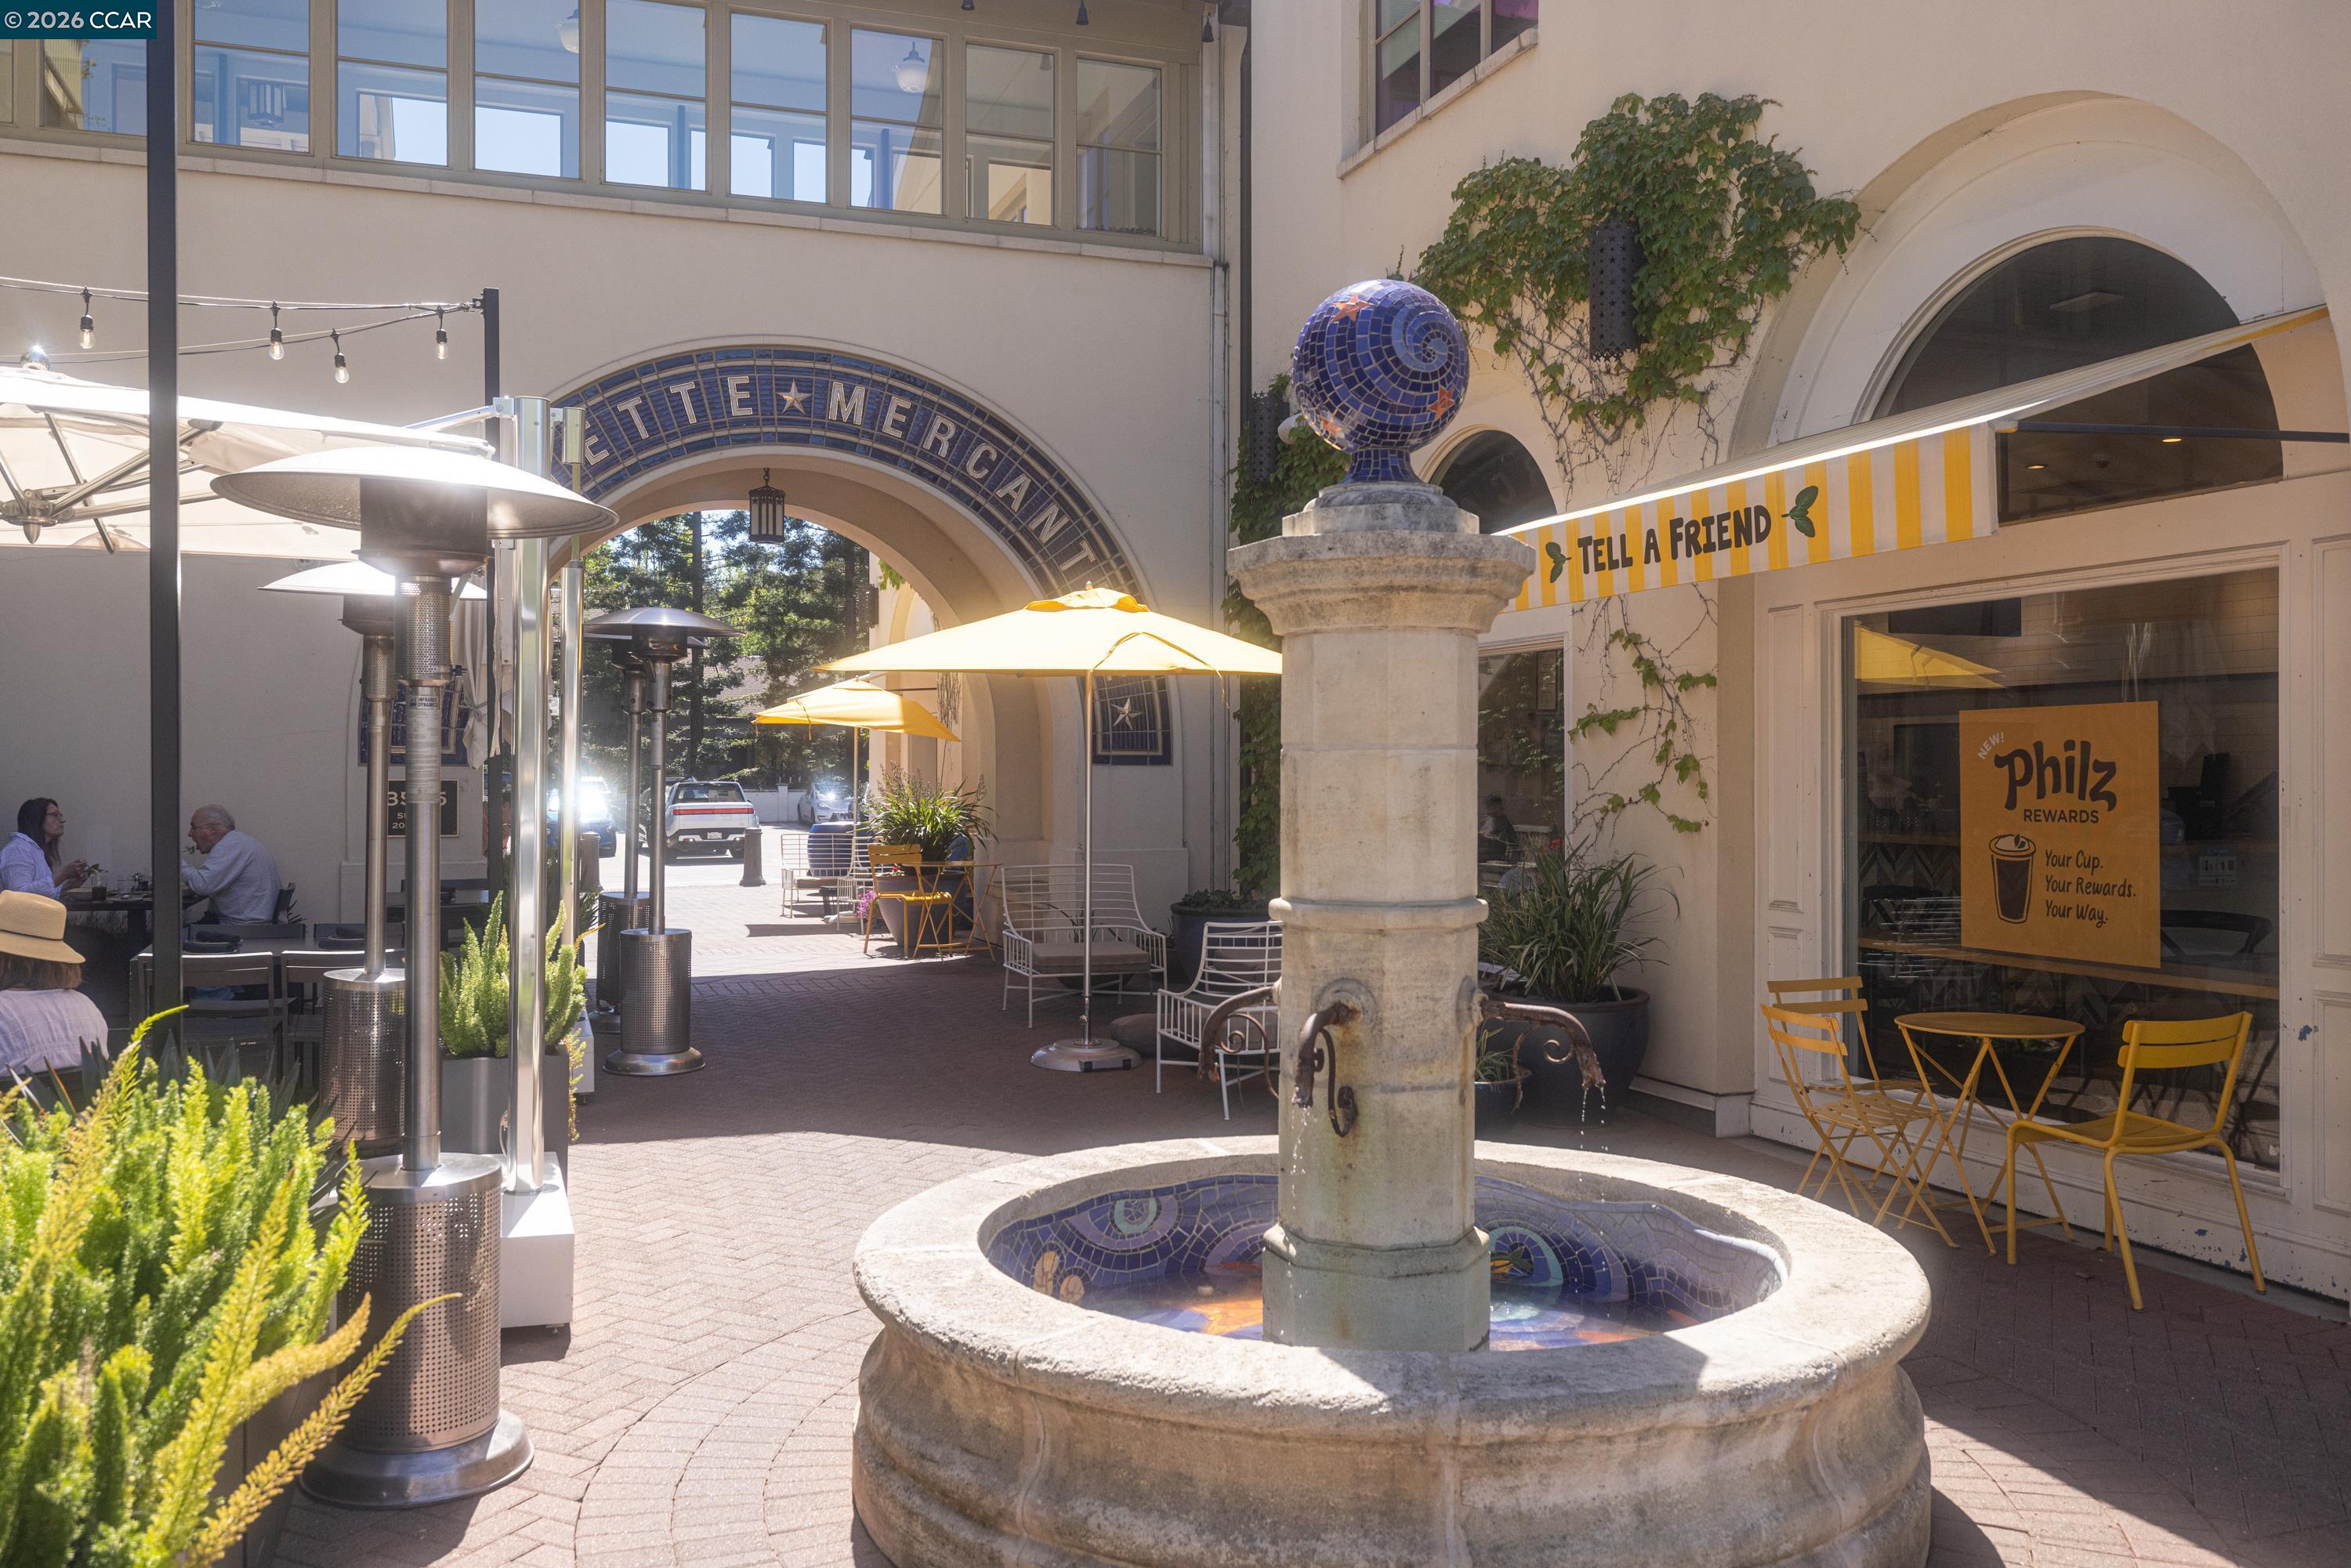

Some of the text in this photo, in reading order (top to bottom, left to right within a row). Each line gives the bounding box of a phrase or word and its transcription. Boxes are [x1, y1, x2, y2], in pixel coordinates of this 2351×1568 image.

[552, 376, 1107, 586] ETTE MERCANT
[1577, 505, 1772, 574] TELL A FRIEND
[1977, 731, 2005, 760] NEW!
[1994, 739, 2117, 812] Philz
[2023, 809, 2099, 824] REWARDS
[2045, 849, 2104, 876] Your Cup.
[2045, 874, 2137, 898] Your Rewards.
[2045, 899, 2109, 929] Your Way.
